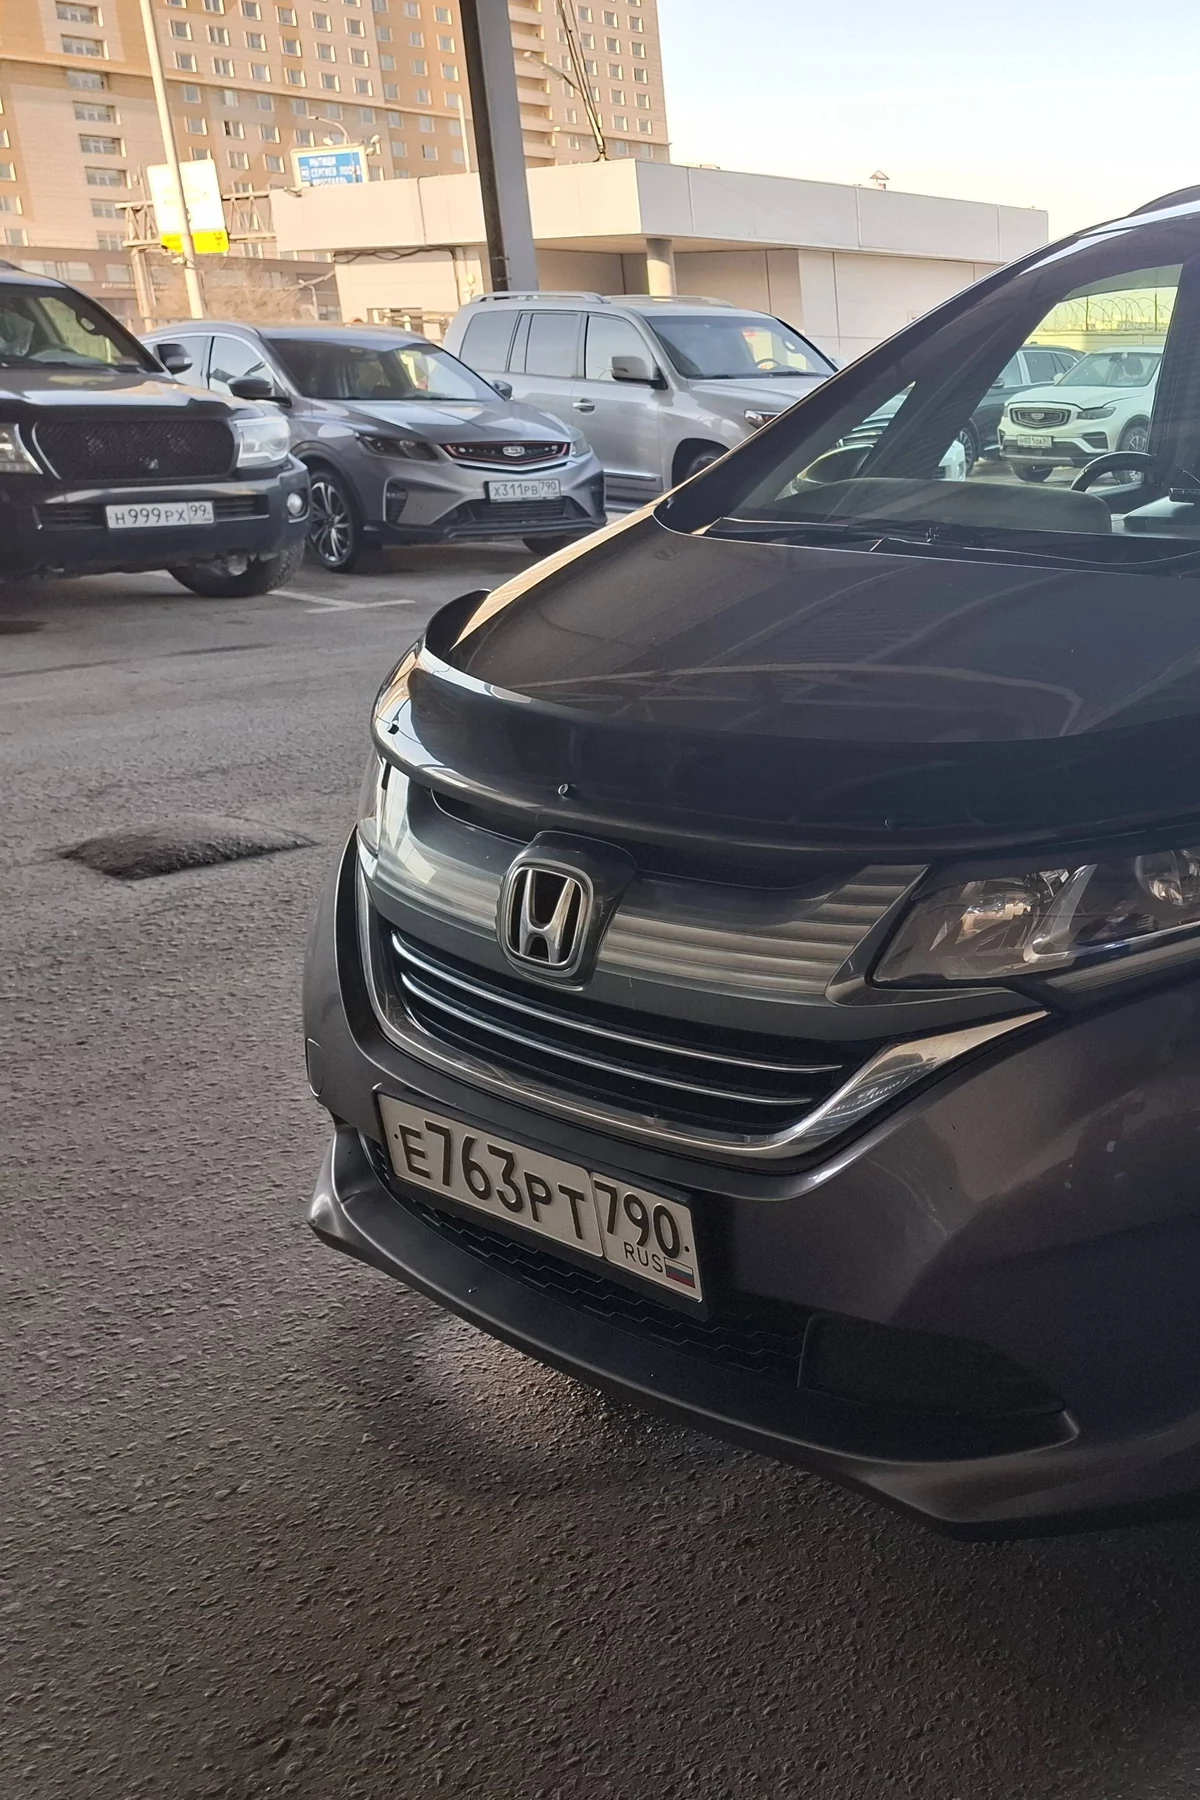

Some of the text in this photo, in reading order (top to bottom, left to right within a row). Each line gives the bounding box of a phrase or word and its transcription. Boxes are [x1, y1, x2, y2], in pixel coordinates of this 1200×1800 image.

[541, 481, 557, 491] 790
[189, 504, 207, 517] 99
[398, 1119, 682, 1260] Е763РТ 790
[623, 1241, 664, 1274] RUS
